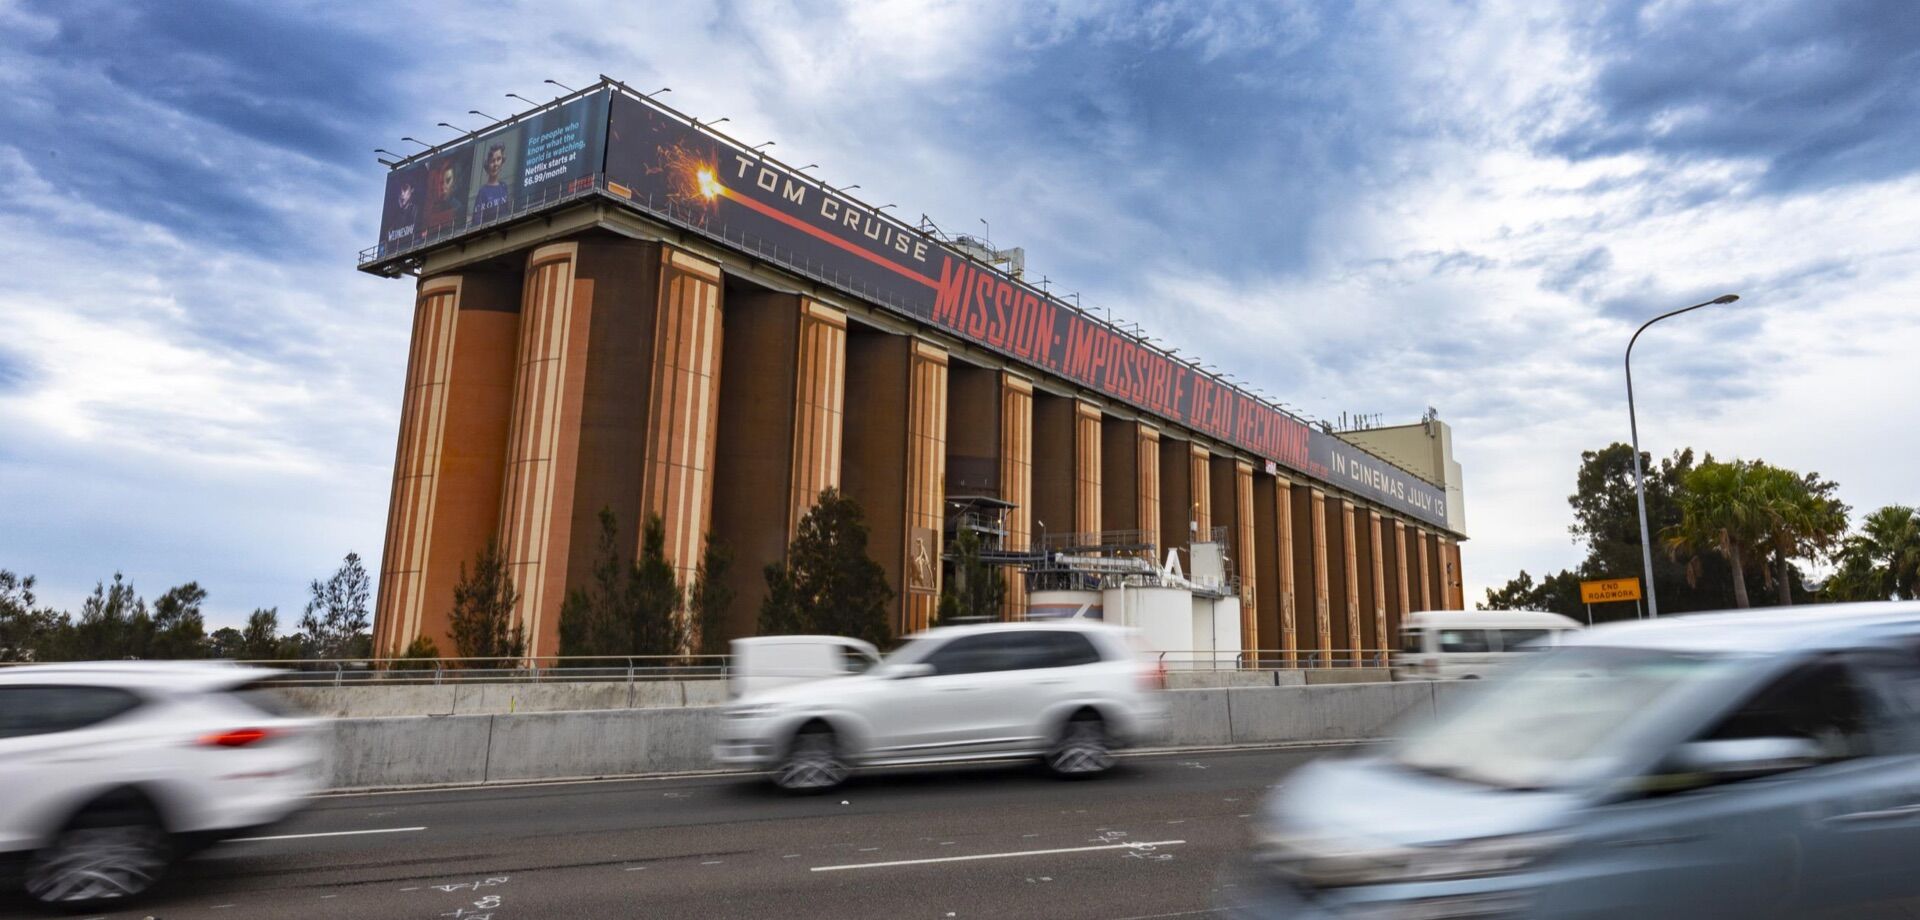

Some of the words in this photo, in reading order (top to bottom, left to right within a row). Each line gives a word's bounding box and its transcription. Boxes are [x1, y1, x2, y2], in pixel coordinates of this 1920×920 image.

[527, 144, 545, 156] know
[546, 137, 562, 149] what
[564, 133, 575, 142] the
[528, 136, 540, 145] For
[541, 127, 563, 142] people
[565, 122, 579, 132] who
[525, 162, 547, 175] Netflix
[548, 155, 568, 169] starts
[569, 151, 576, 160] at
[526, 152, 545, 166] world
[524, 165, 567, 187] $6.99/month
[735, 154, 806, 205] TOM
[820, 196, 929, 263] CRUISE
[931, 254, 1061, 369] MISSION:
[1062, 314, 1186, 421] IMPOSSIBLE
[1190, 375, 1233, 439] DEAD
[1235, 395, 1310, 469] RECKONING
[1331, 450, 1345, 476] IN
[1350, 459, 1404, 500] CINEMAS
[1407, 487, 1432, 511] JULY
[1434, 498, 1444, 517] 13
[1588, 590, 1634, 599] ROADWORK
